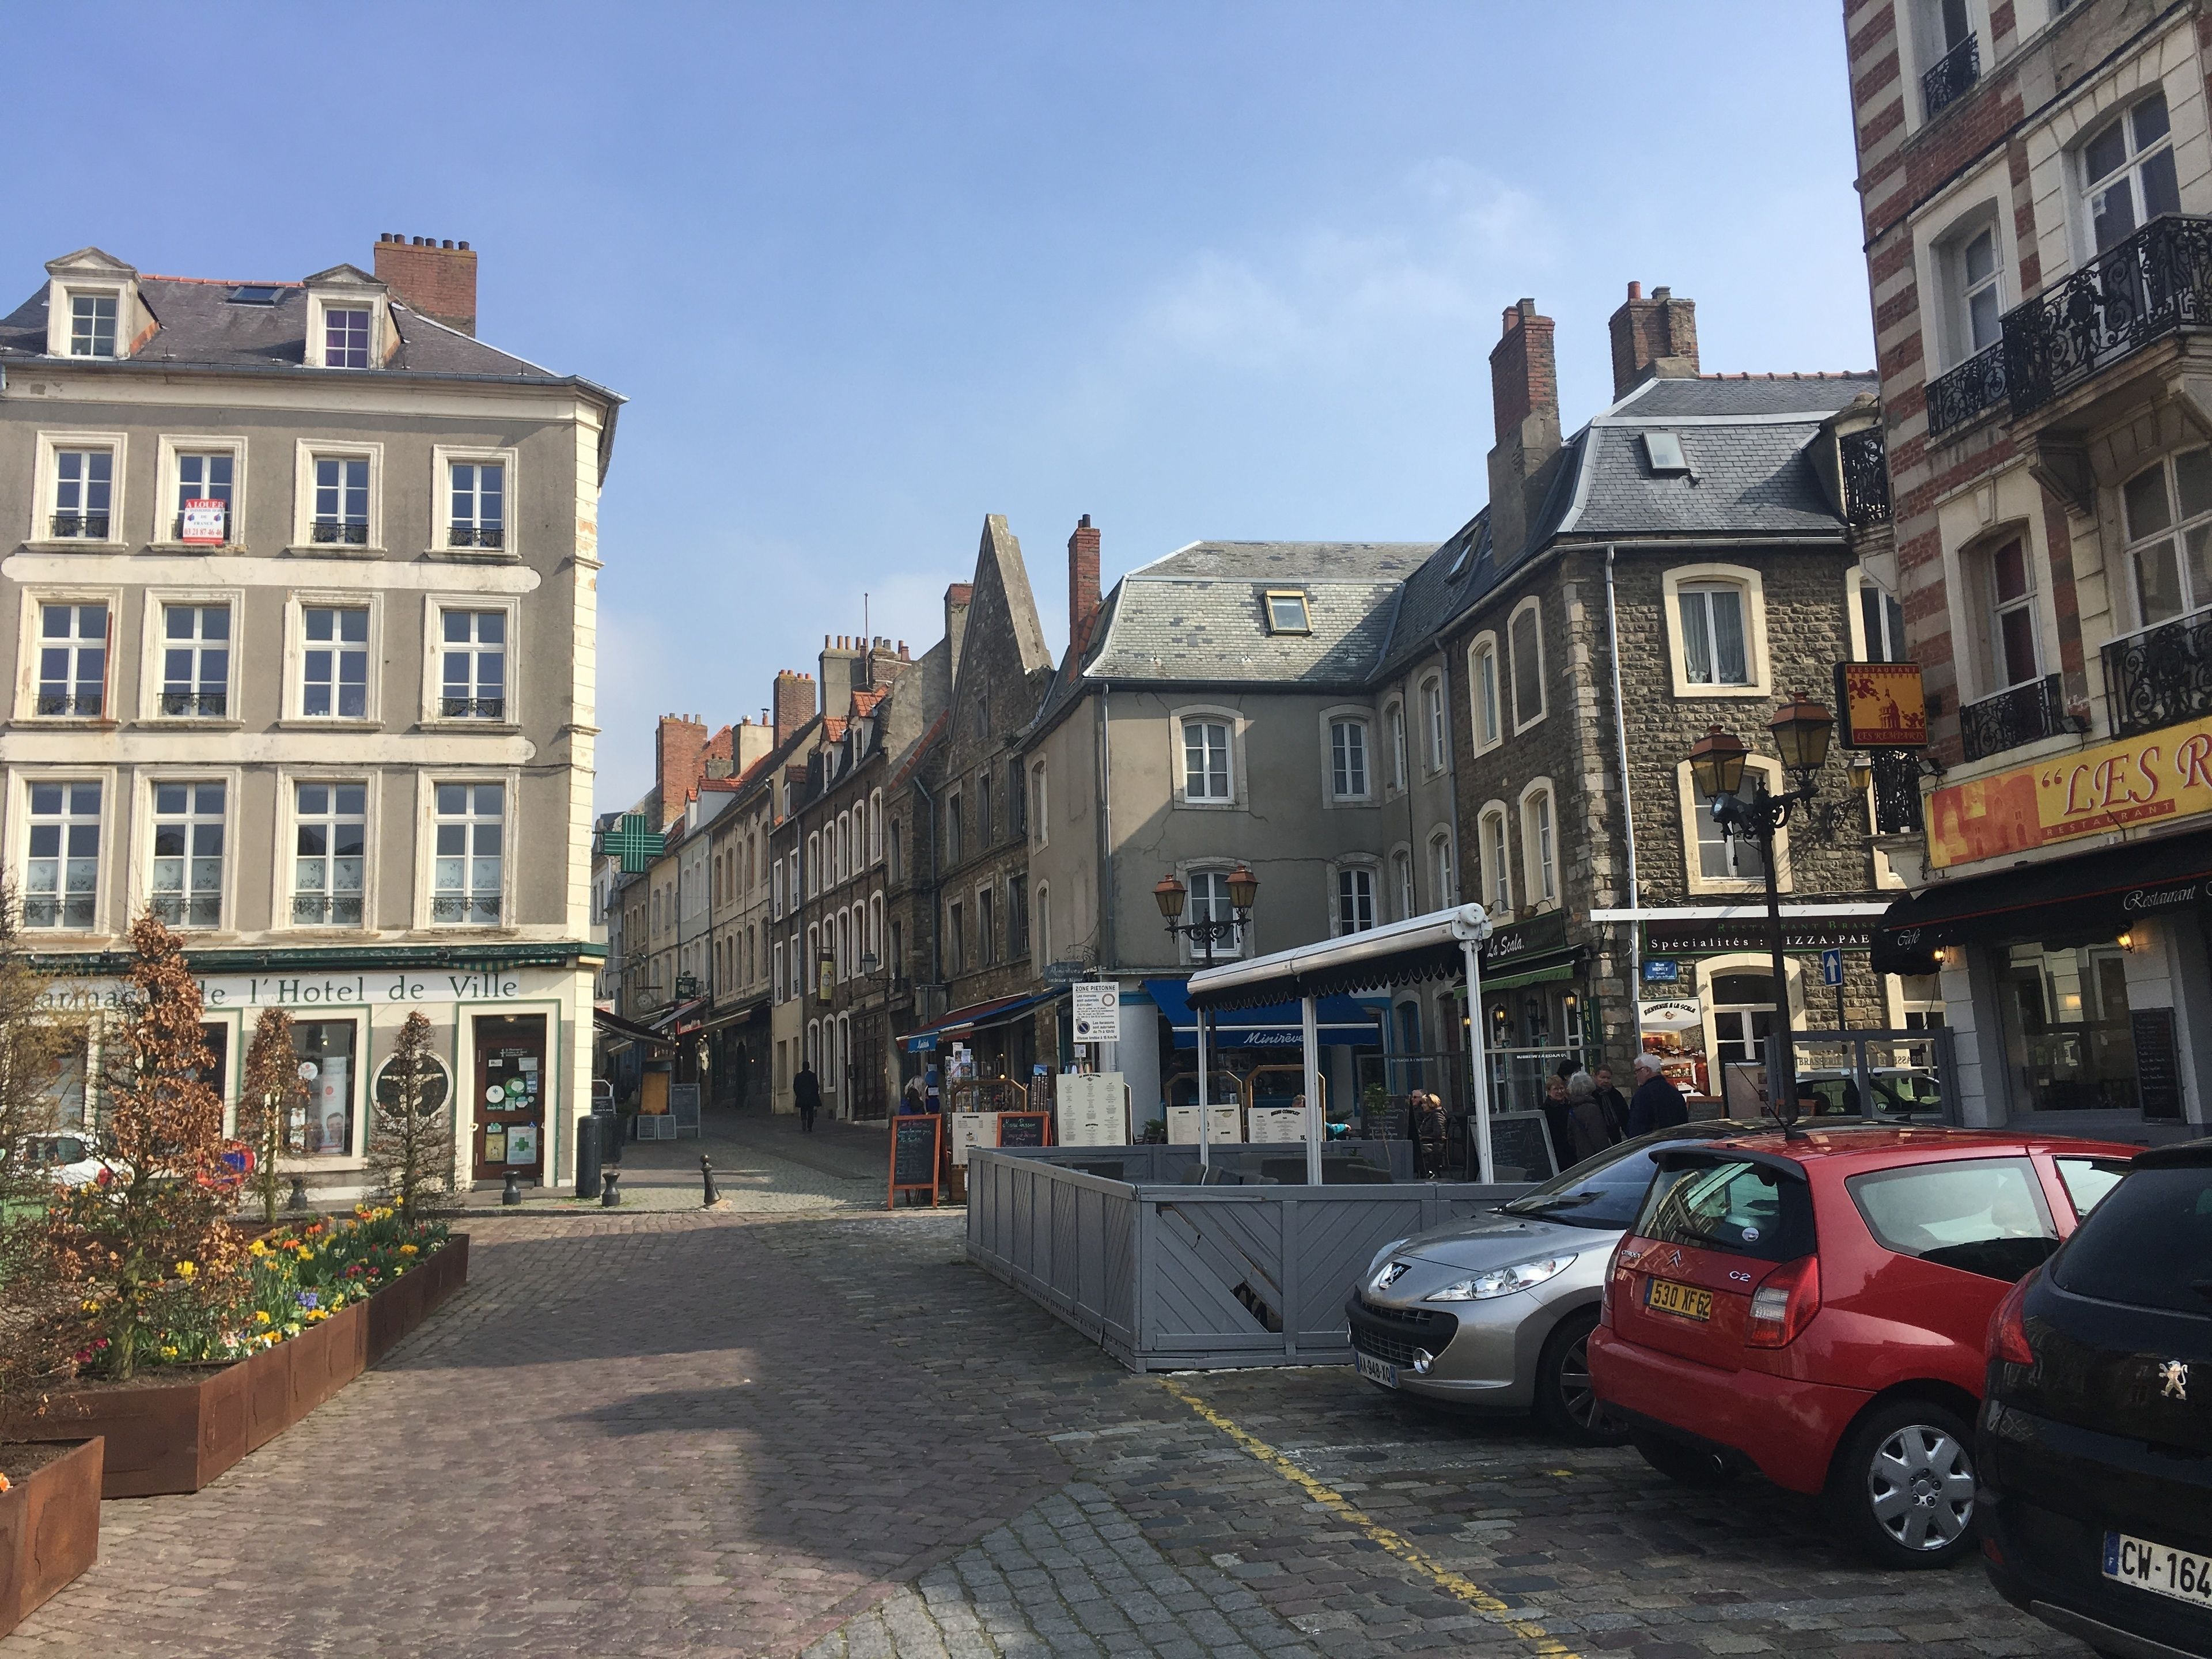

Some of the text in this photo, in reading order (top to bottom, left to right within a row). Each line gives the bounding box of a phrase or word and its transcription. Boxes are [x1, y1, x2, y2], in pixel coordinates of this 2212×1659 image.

[2046, 802, 2171, 836] RESTAURANT
[2123, 885, 2196, 911] Restaurant
[1718, 921, 1876, 932] RESTARANT BRASS
[1487, 938, 1498, 957] La
[1651, 937, 1749, 950] Spécialités
[389, 975, 425, 1001] de
[448, 972, 518, 999] Ville
[1643, 1002, 1669, 1016] BIENVENUE
[1680, 1004, 1696, 1014] SCALA
[1243, 1032, 1304, 1044] Minirêve
[1729, 1271, 1751, 1282] C2
[1653, 1283, 1679, 1308] 530
[2122, 1540, 2212, 1599] CW-164
